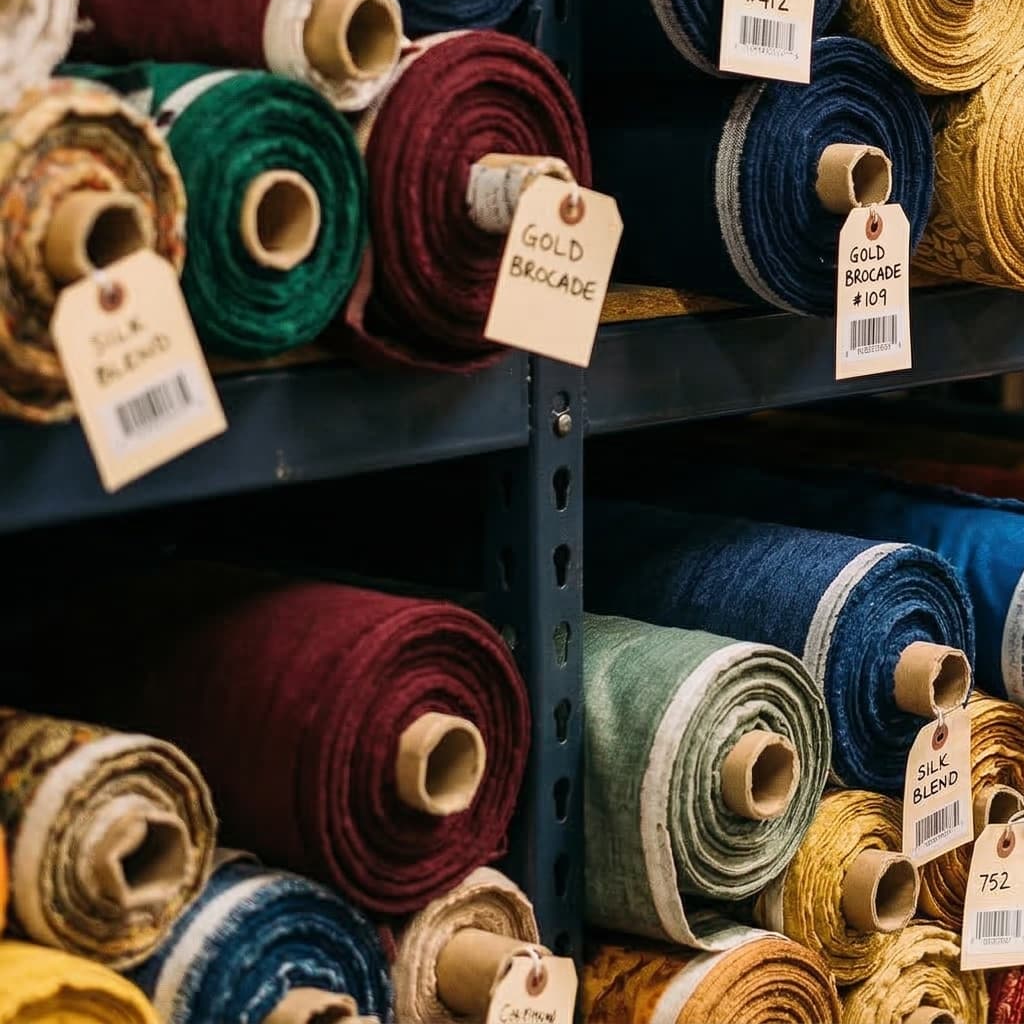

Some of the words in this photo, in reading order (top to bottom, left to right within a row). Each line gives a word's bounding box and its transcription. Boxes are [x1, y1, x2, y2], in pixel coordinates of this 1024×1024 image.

[521, 223, 584, 262] GOLD
[850, 245, 886, 263] GOLD
[509, 255, 597, 301] BROCADE
[845, 263, 901, 287] BROCADE
[852, 288, 887, 307] #109
[917, 753, 950, 781] SILK
[912, 770, 958, 805] BLEND
[979, 871, 1011, 893] 752
